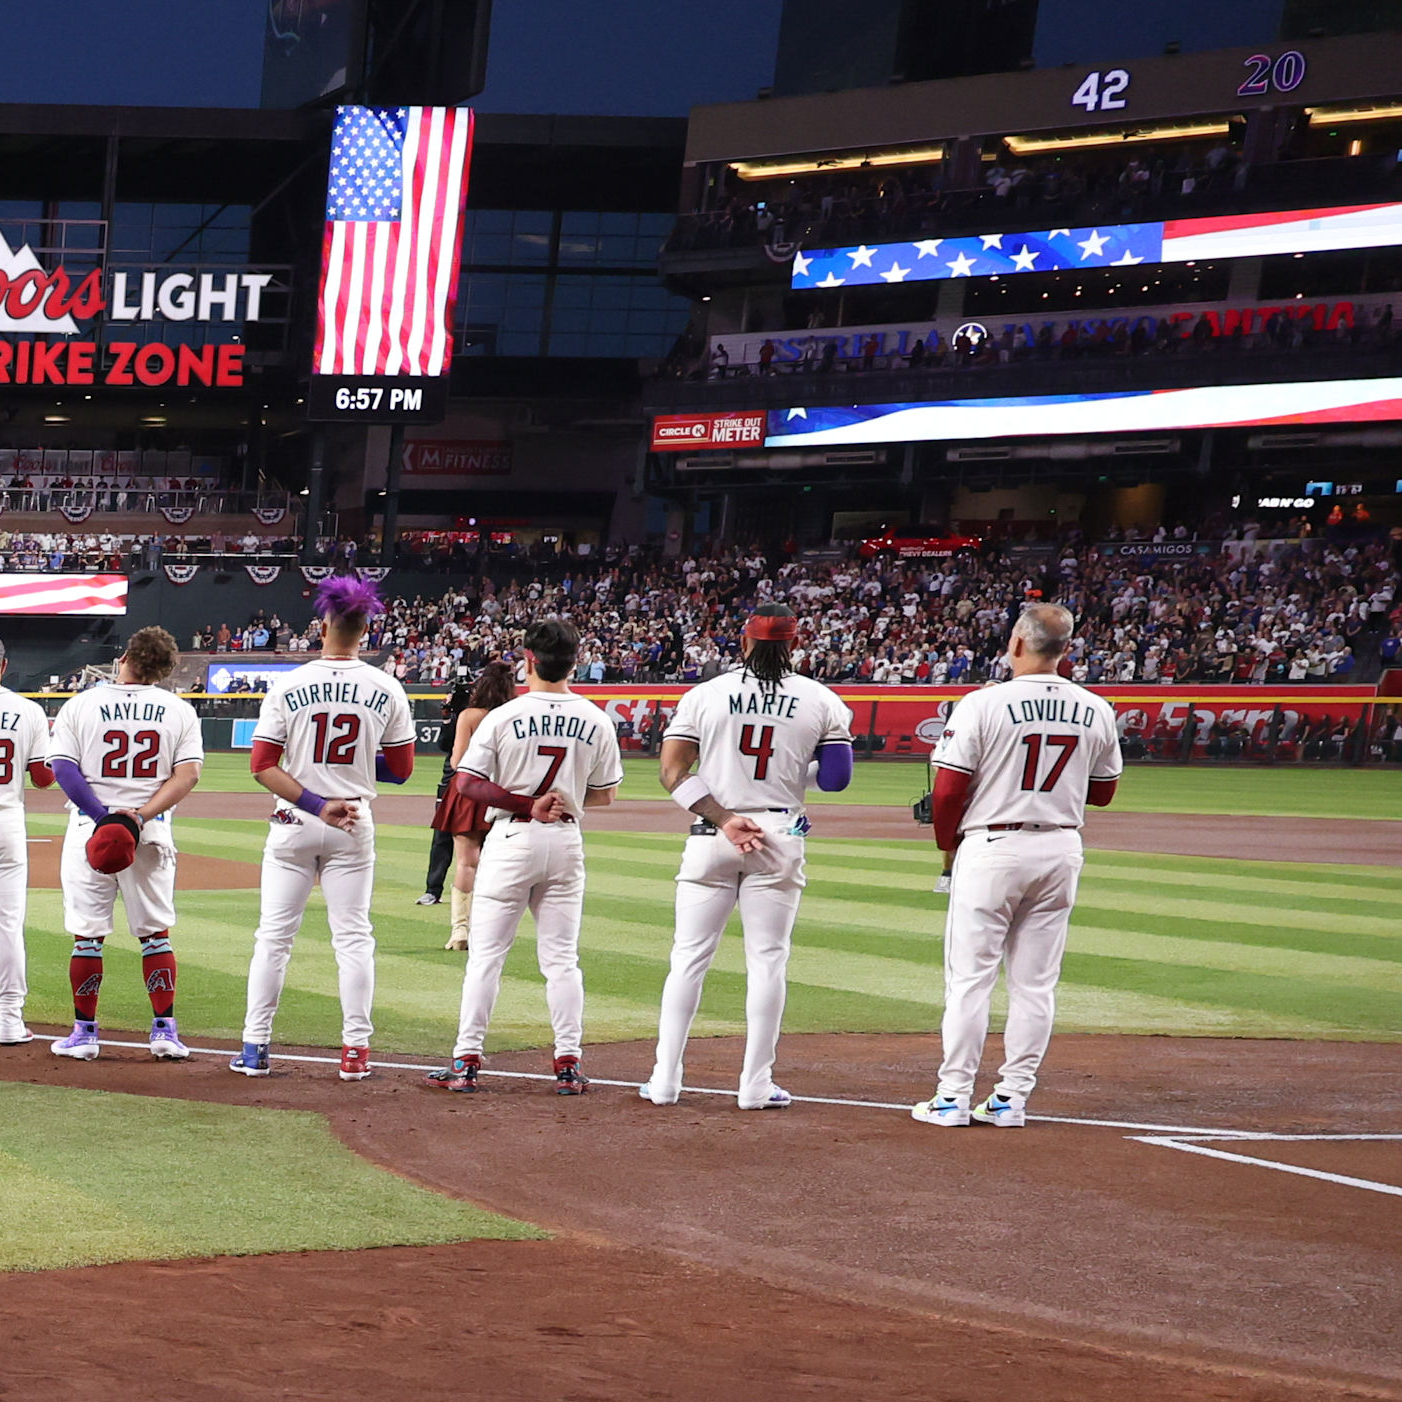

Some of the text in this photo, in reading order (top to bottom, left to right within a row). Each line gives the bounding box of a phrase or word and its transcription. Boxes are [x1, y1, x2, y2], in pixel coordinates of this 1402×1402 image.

[1072, 69, 1130, 112] 42
[1237, 51, 1306, 96] 20
[111, 272, 274, 322] LIGHT
[104, 342, 246, 387] ZONE
[335, 387, 423, 411] 6:57 PM
[659, 424, 705, 438] CIRCLE K
[711, 427, 761, 443] METER
[713, 417, 763, 429] STRIKE OUT
[1293, 498, 1315, 508] GO
[99, 701, 167, 724] NAYLOR
[284, 682, 388, 718] GURRIEL JR.
[728, 691, 801, 720] MARTE
[1006, 701, 1096, 729] LOVULLO
[310, 711, 361, 765] 12
[419, 725, 442, 744] 37
[511, 714, 597, 746] CARROLL
[101, 729, 161, 779] 22
[738, 724, 775, 781] 4
[1021, 732, 1080, 793] 17
[534, 745, 568, 796] 7
